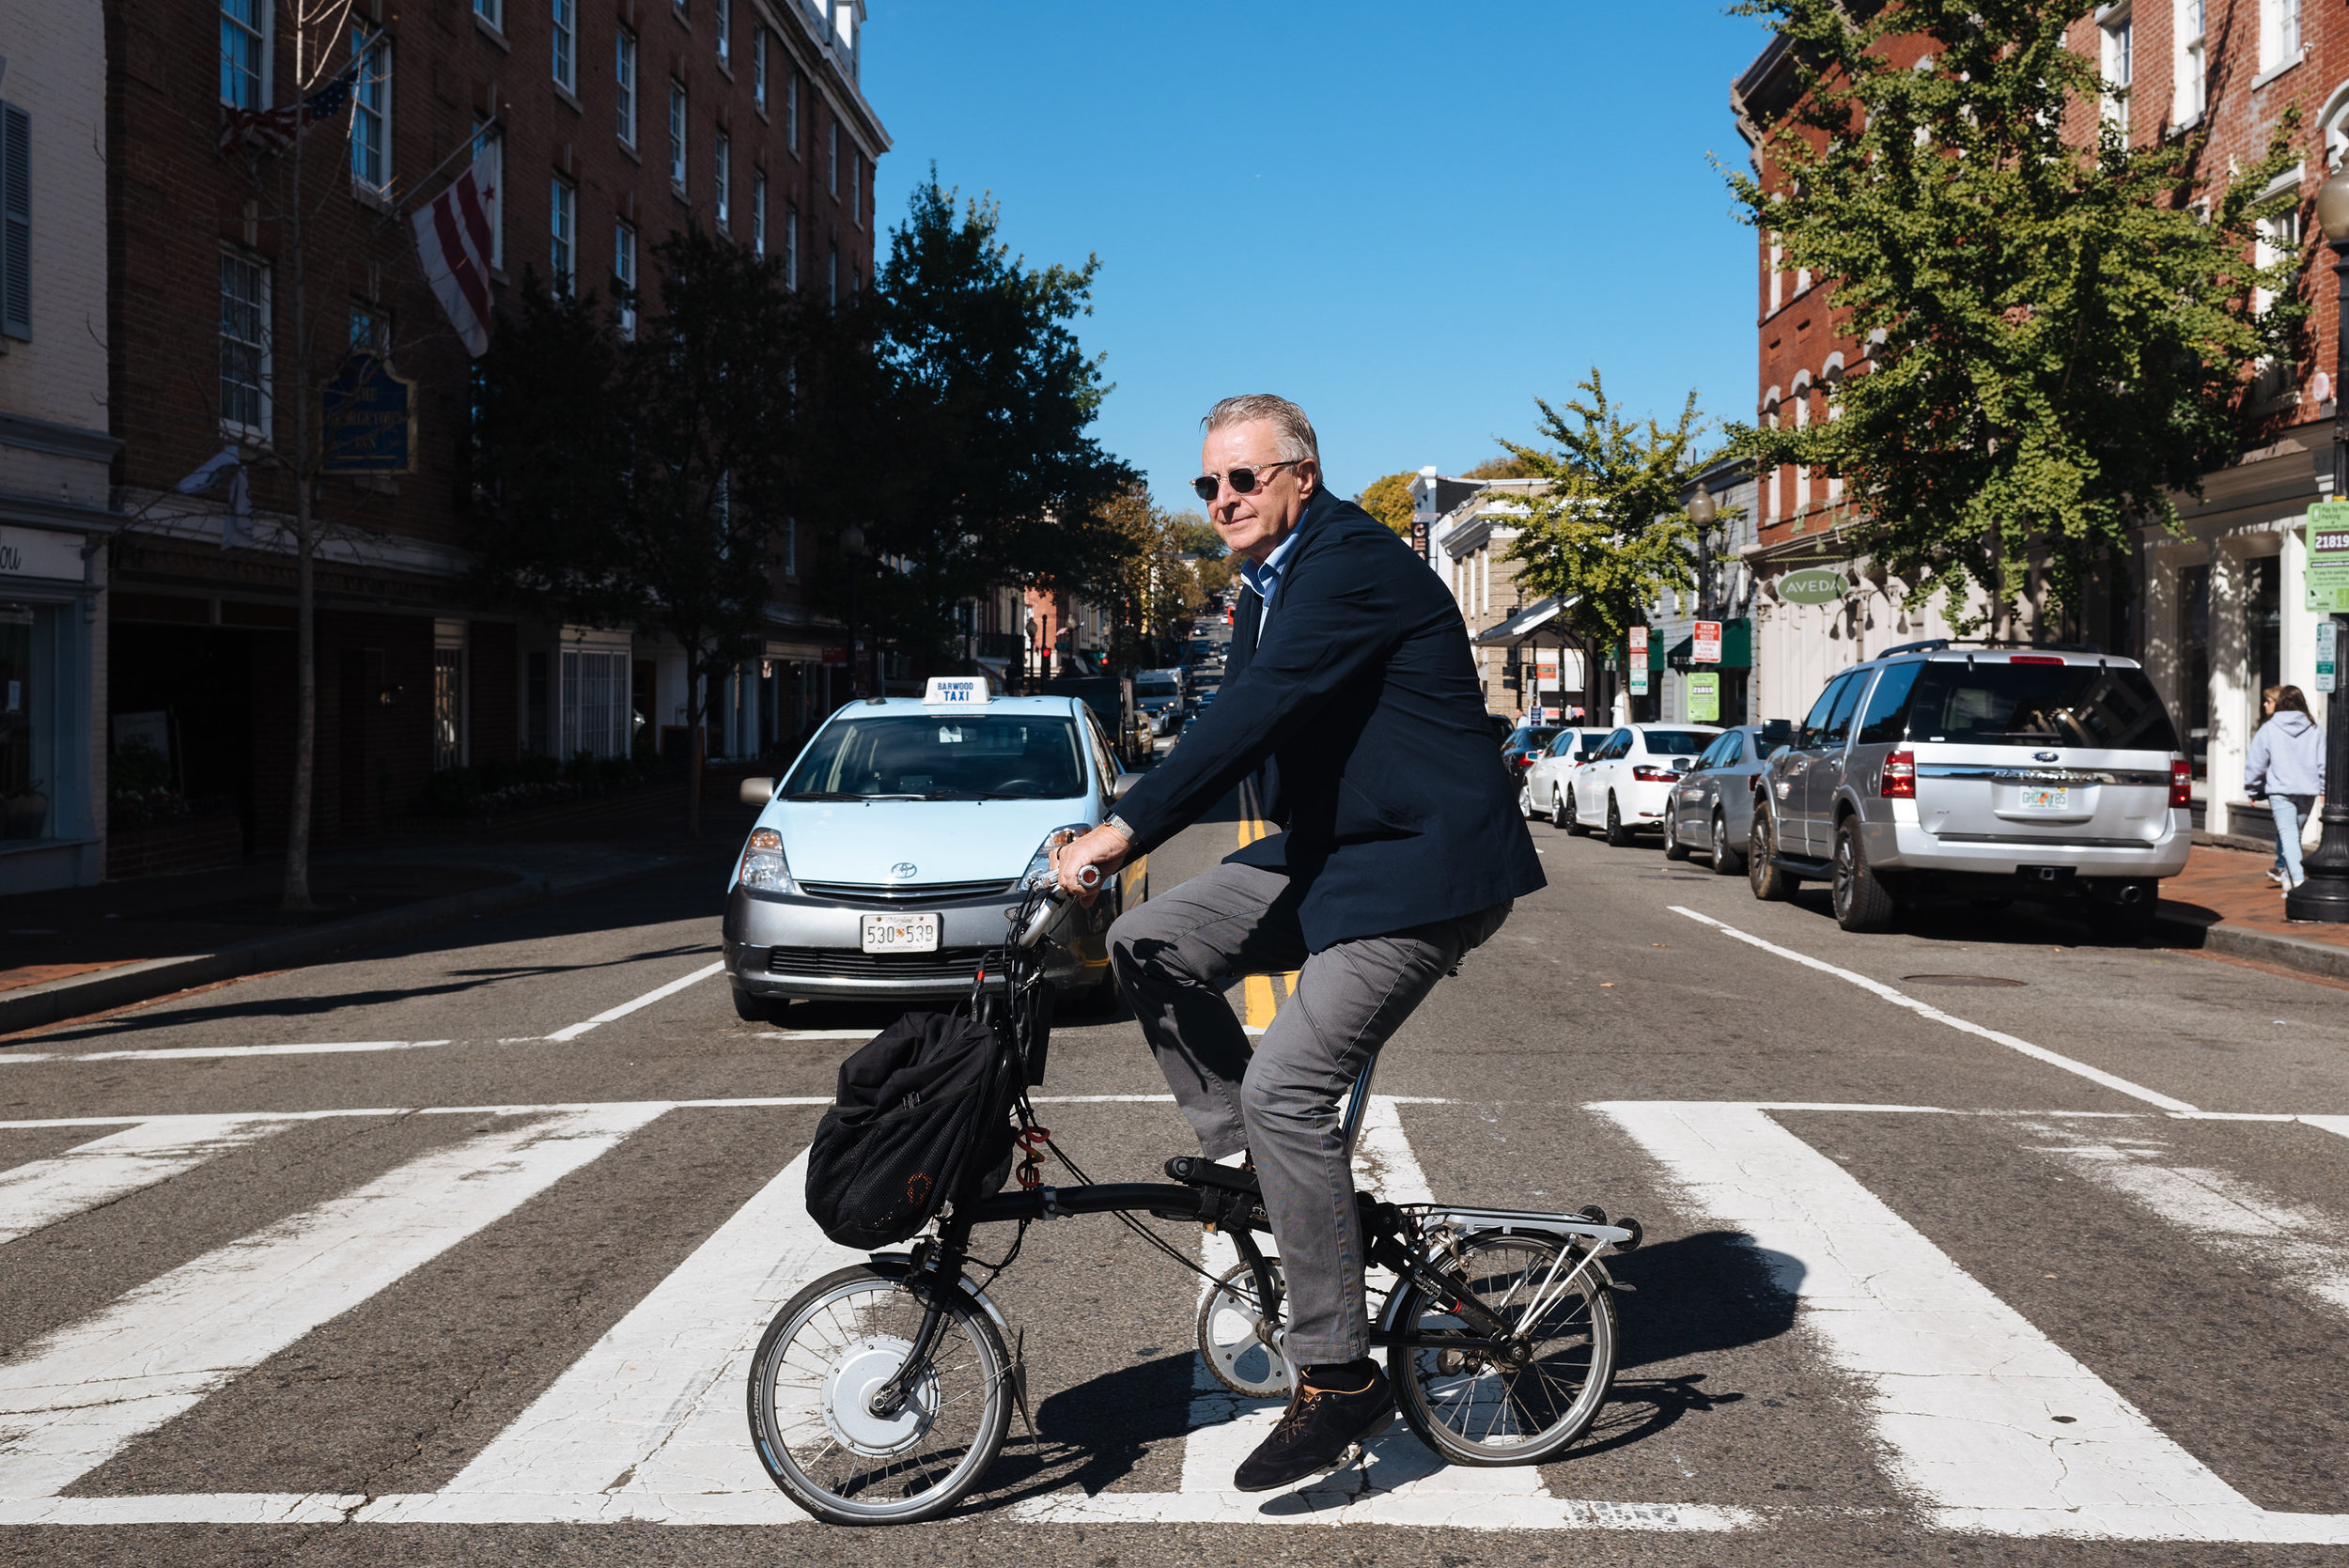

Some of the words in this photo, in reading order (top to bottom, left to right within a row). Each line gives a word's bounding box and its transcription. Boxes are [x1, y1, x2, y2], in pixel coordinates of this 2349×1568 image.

[2315, 535, 2349, 549] 21819
[1786, 580, 1841, 593] AVEDA
[937, 682, 973, 691] BARWOOD
[943, 691, 970, 701] TAXI
[867, 925, 894, 943] 530
